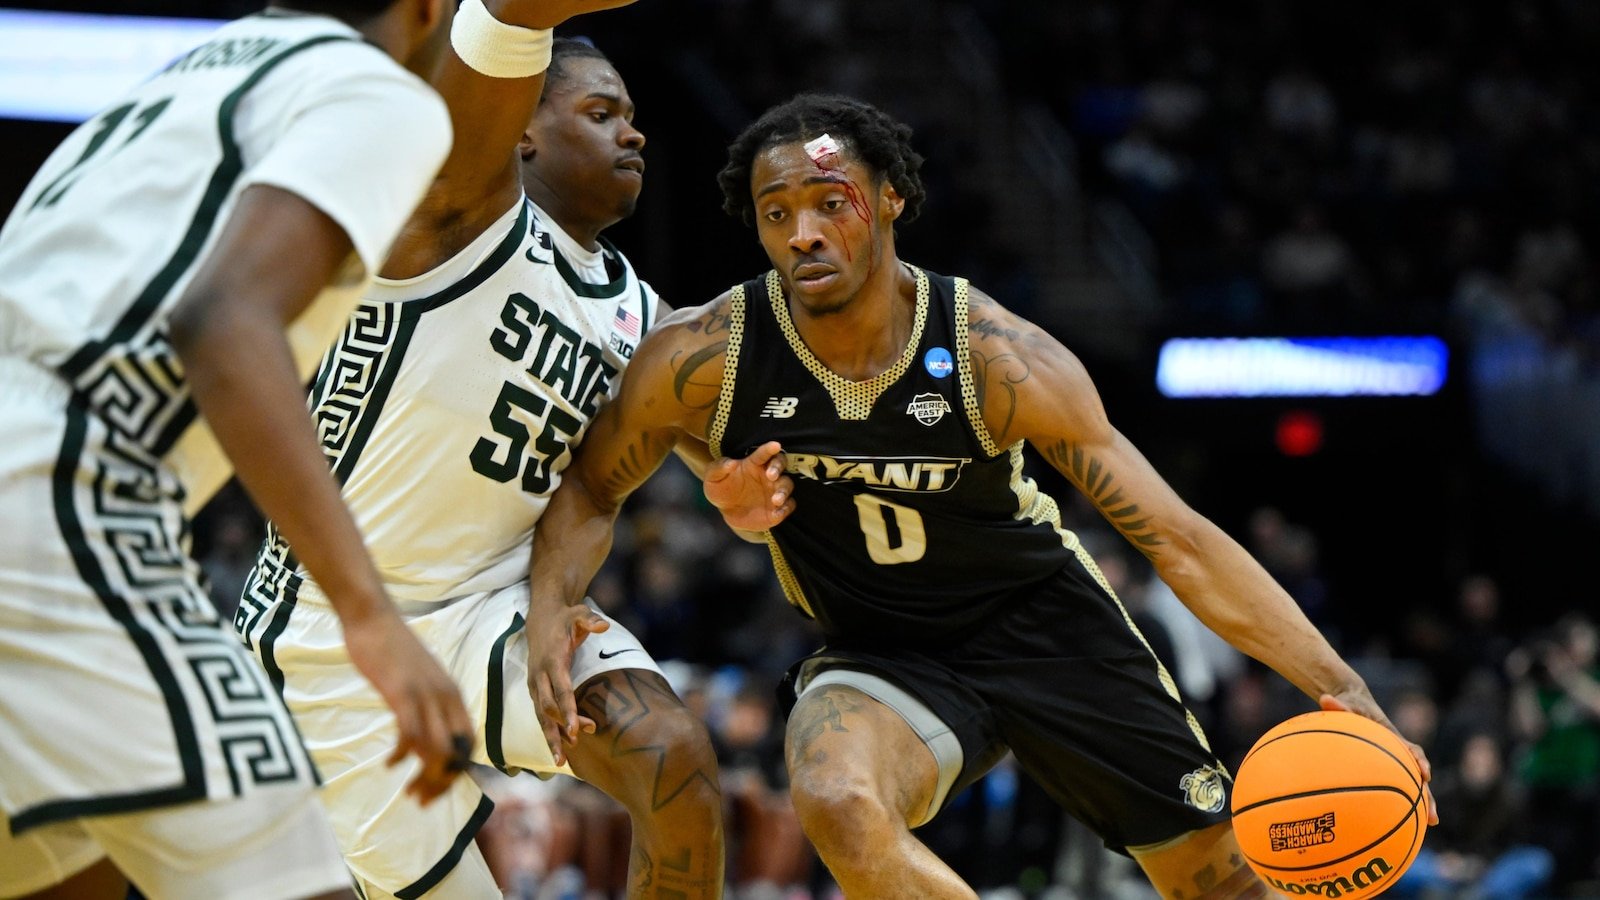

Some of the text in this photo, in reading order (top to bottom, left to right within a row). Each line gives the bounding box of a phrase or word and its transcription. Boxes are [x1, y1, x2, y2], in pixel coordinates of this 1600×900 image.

[489, 292, 618, 418] STATE
[909, 402, 949, 414] AMERICA
[918, 409, 940, 417] EAST
[469, 380, 583, 494] 55
[785, 453, 957, 490] RYANT
[853, 493, 927, 565] 0
[1270, 821, 1316, 839] MADNESS
[1287, 832, 1322, 848] MARCH
[1263, 857, 1393, 898] Wilson
